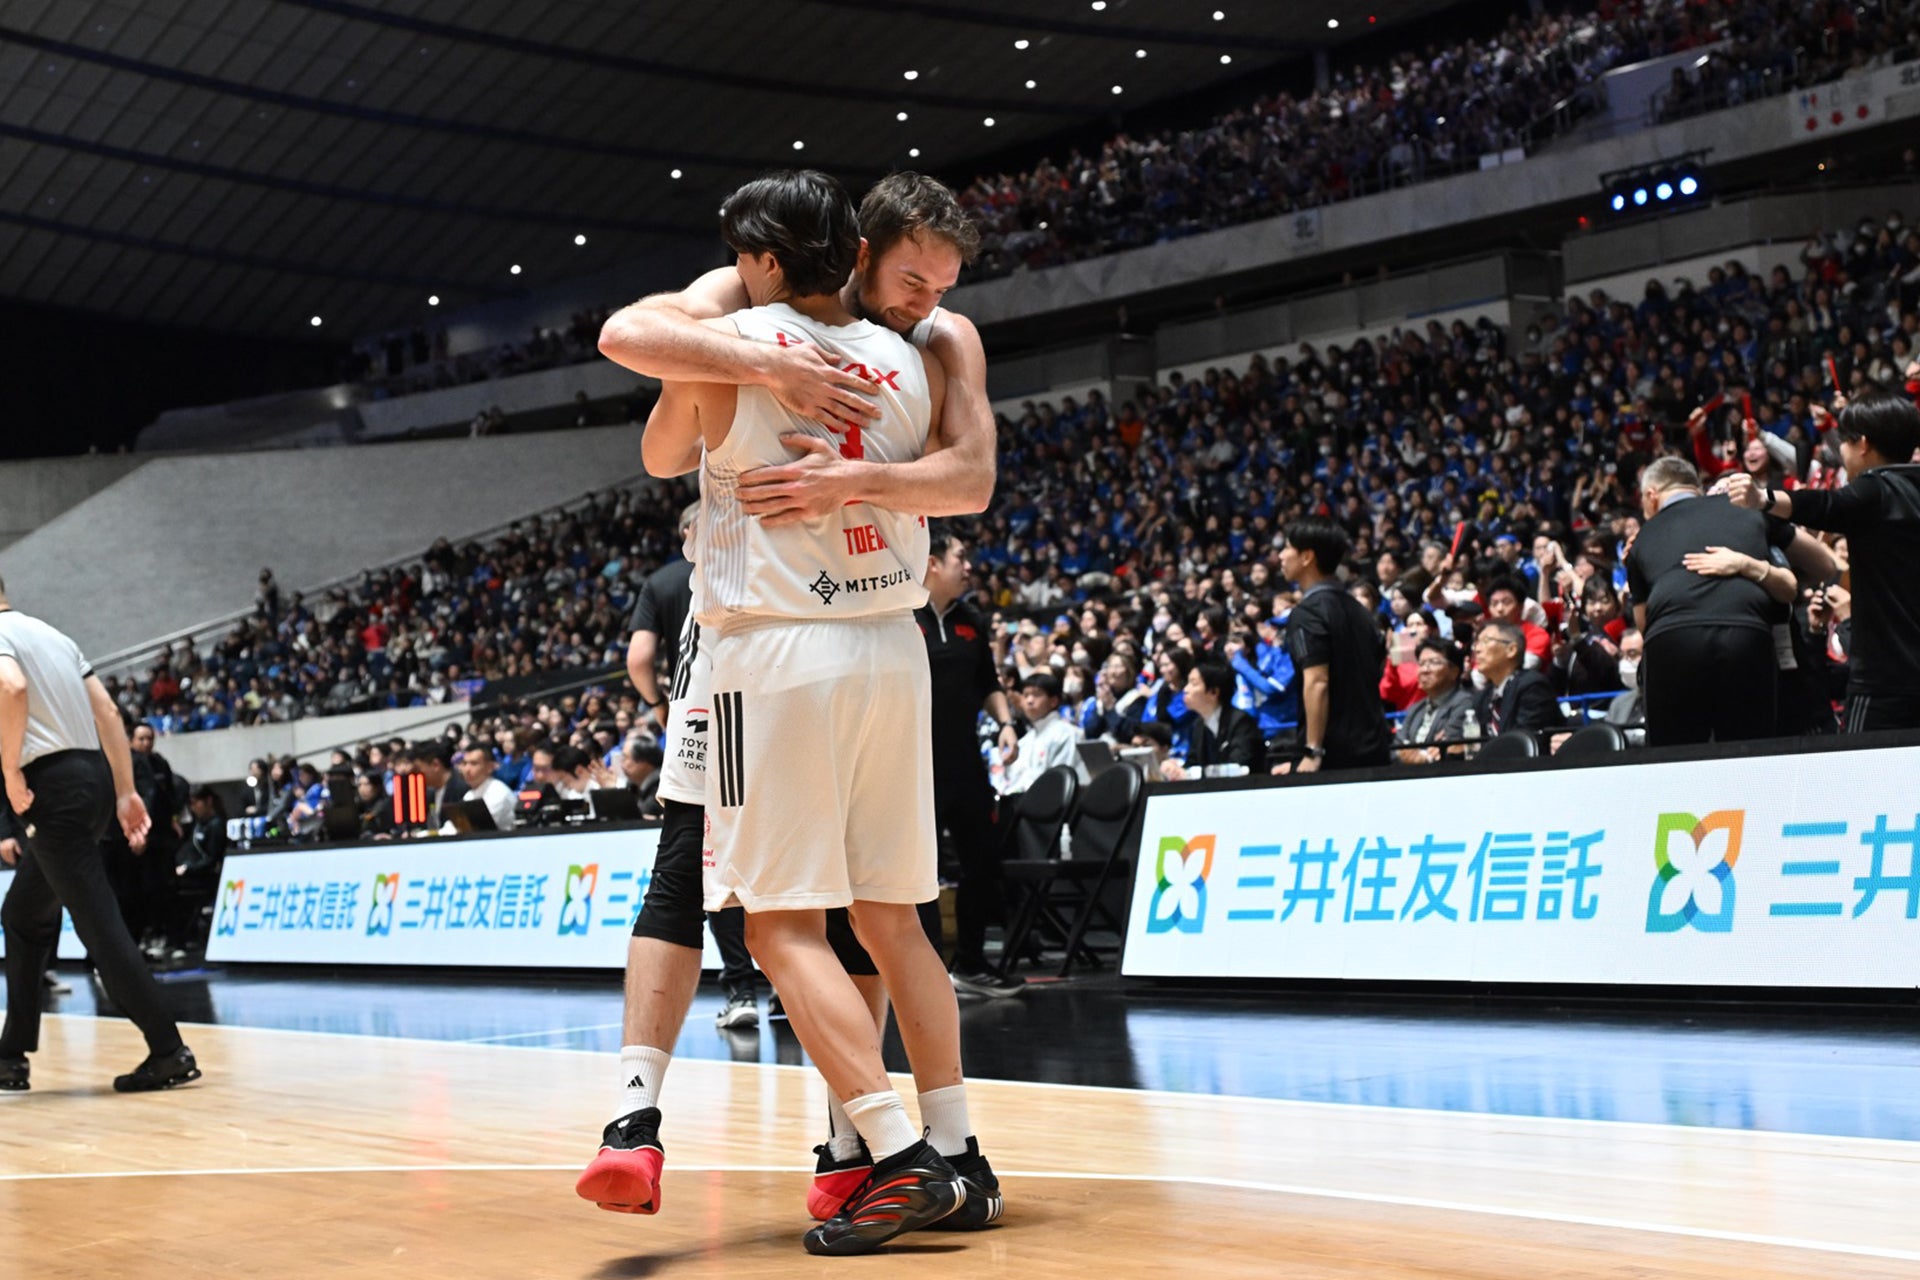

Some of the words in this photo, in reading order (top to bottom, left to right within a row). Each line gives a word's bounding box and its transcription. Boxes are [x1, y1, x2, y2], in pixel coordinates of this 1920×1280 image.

[845, 571, 903, 593] MITSUI
[1227, 829, 1605, 923] 三井住友信託
[1769, 813, 1920, 919] 三井
[243, 882, 360, 930] 三井住友信託
[400, 874, 549, 930] 三井住友信託
